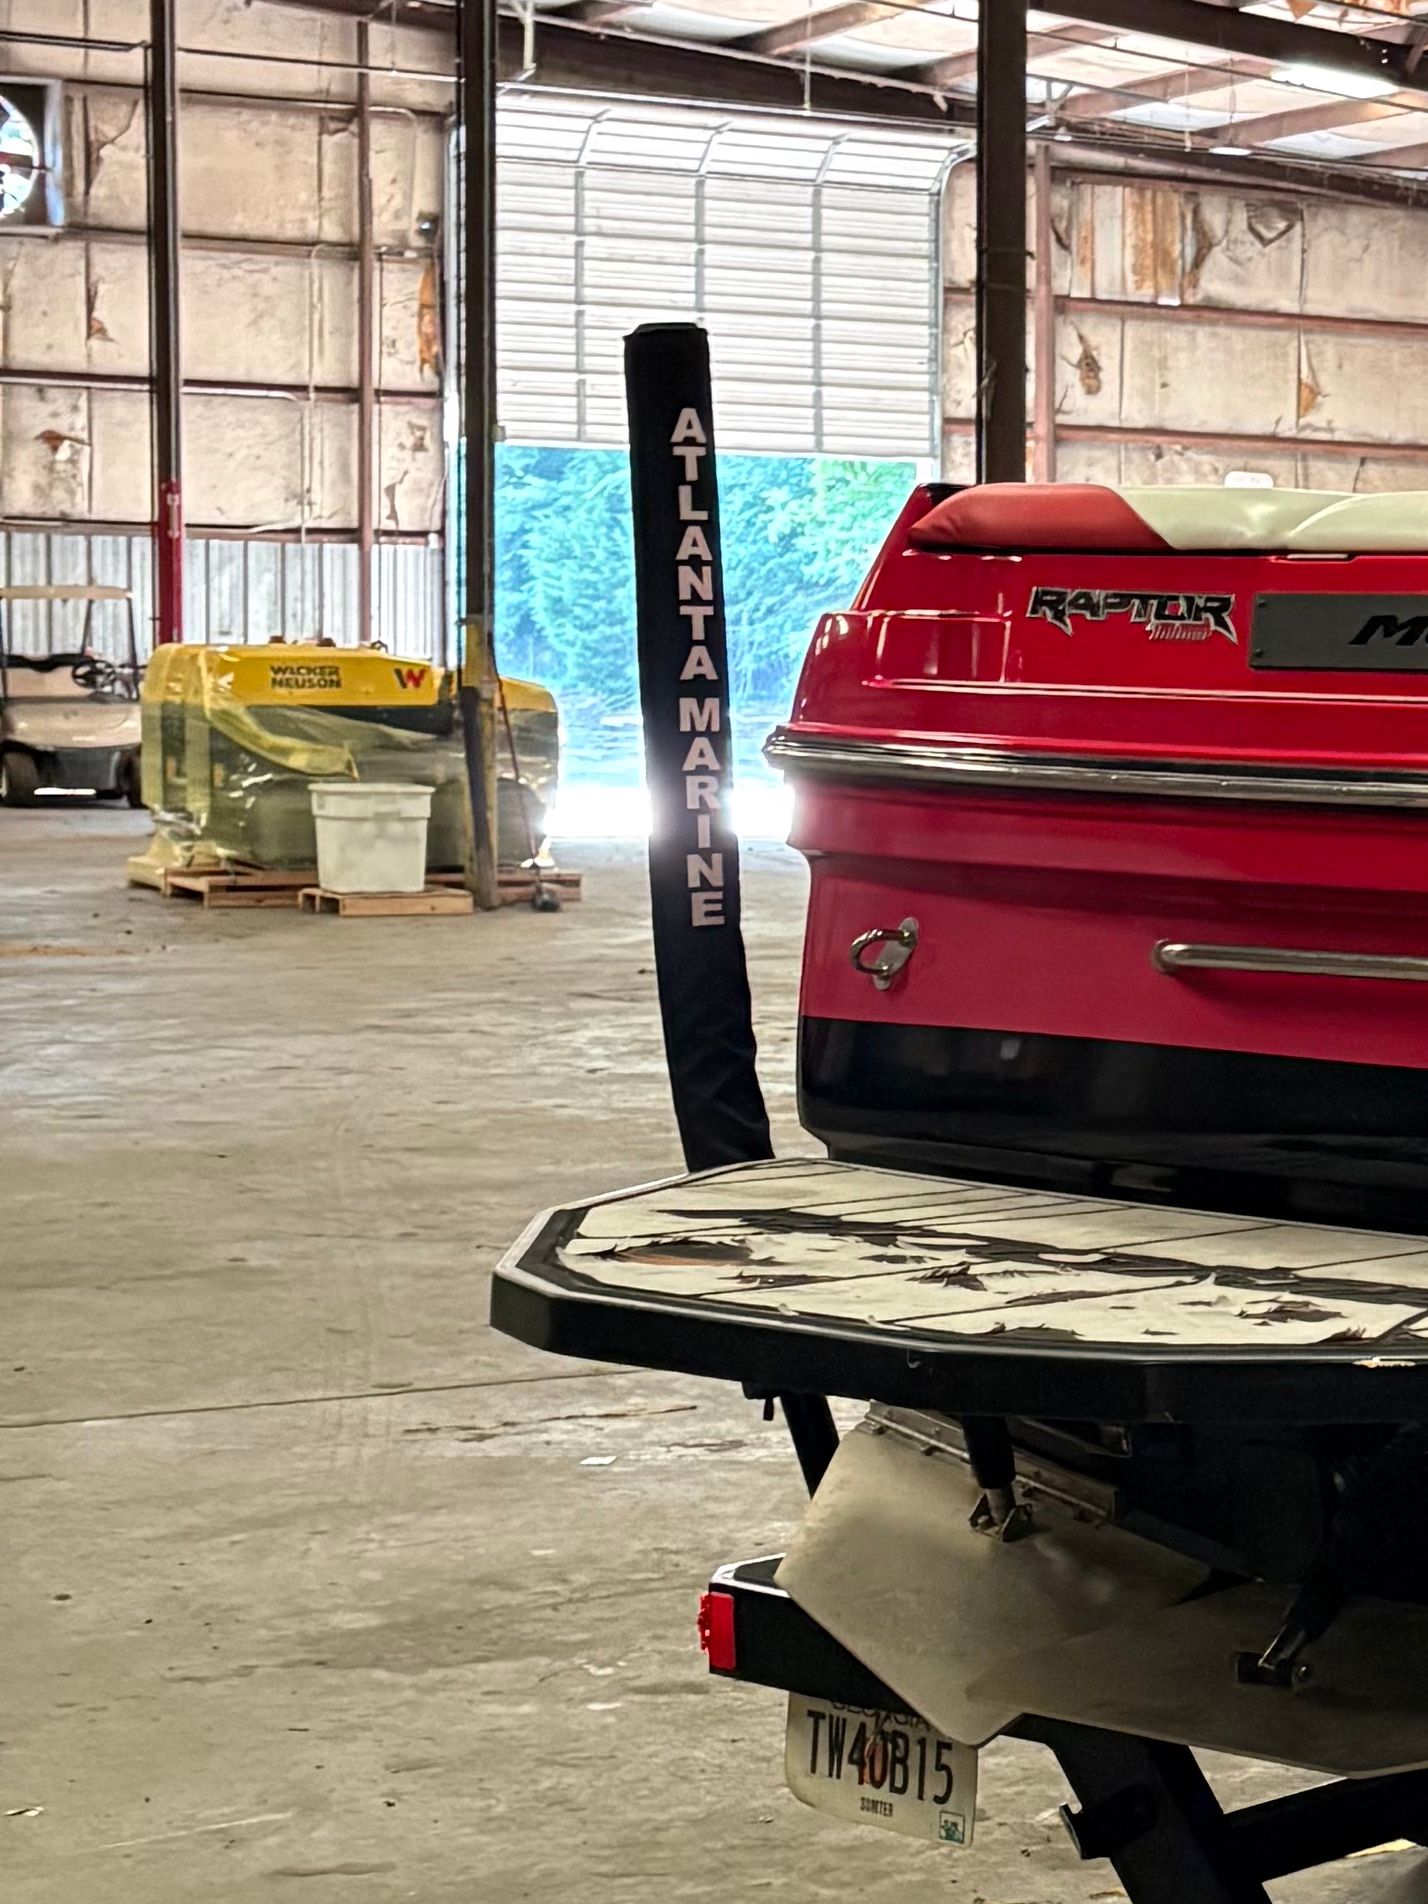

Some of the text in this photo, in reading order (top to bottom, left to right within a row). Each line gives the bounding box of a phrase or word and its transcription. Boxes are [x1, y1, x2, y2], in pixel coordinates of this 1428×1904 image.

[1026, 586, 1238, 644] RAPTOR
[270, 665, 341, 677] WACKER
[271, 677, 342, 689] NEUSON
[670, 407, 725, 928] ATLANTA MARINE
[807, 1709, 954, 1805] TW40B15
